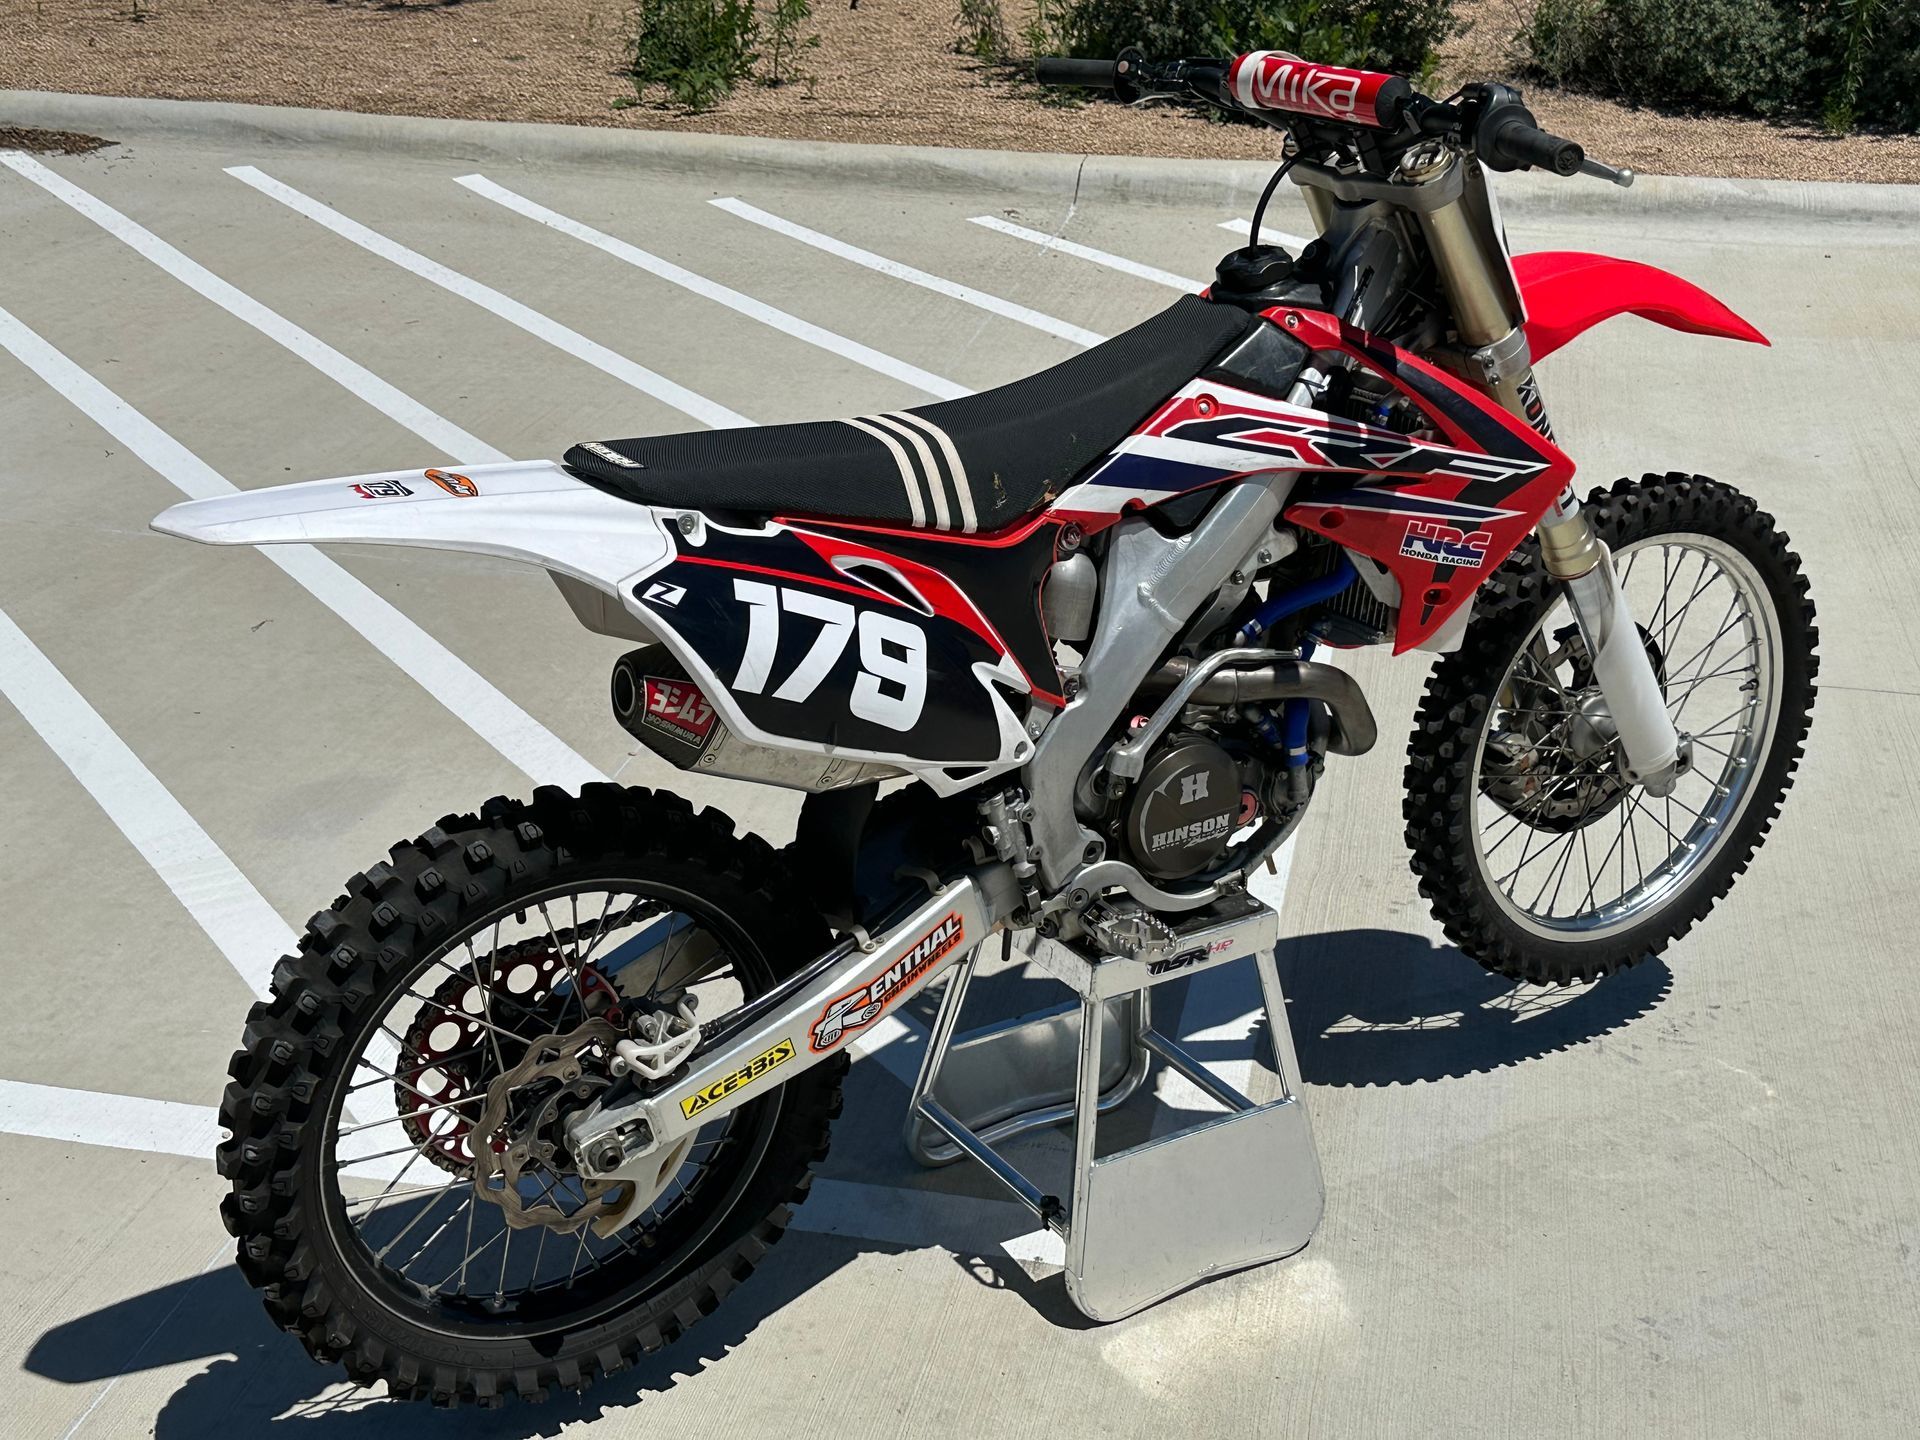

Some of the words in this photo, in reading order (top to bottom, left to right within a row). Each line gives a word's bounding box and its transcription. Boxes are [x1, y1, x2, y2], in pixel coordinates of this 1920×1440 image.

[1256, 60, 1362, 118] Mika
[1400, 547, 1440, 562] HONDA
[1441, 555, 1482, 567] RACING
[1401, 520, 1493, 559] HRC
[731, 578, 928, 733] 179
[645, 712, 702, 745] YOSHIMURA
[1180, 770, 1210, 805] H
[1151, 813, 1231, 849] HINSON
[884, 931, 962, 1004] CHAINWHEELS
[688, 1045, 792, 1115] ACERBIS
